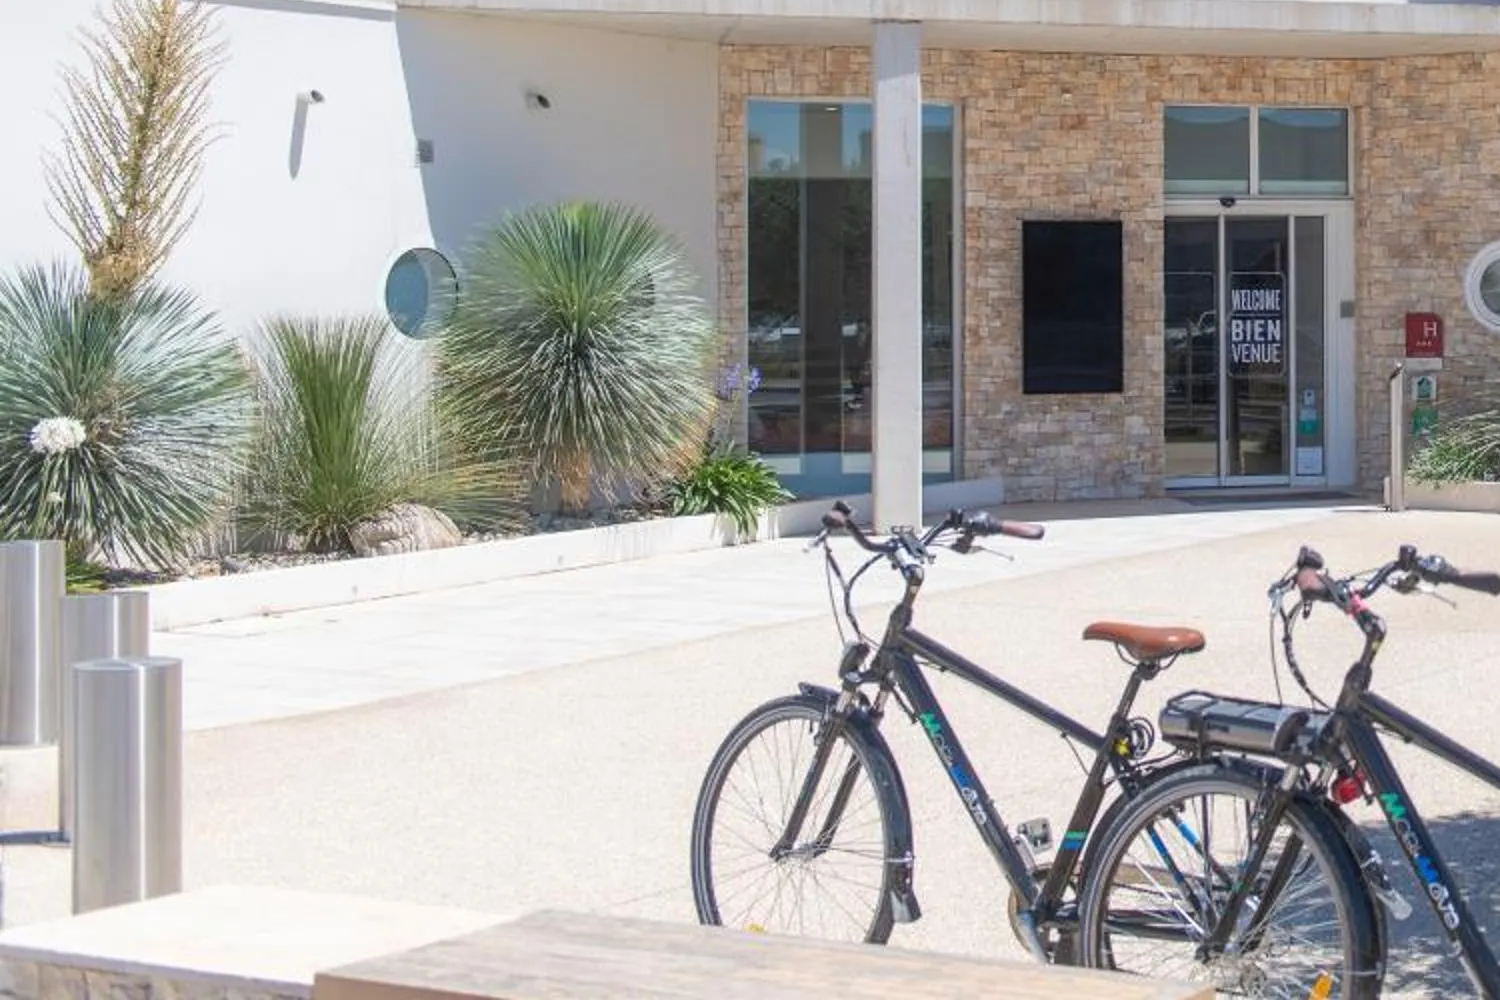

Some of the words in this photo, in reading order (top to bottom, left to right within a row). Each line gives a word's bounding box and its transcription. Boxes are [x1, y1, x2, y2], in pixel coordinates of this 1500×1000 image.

[1231, 289, 1281, 311] WELCOME
[1231, 319, 1281, 342] BIEN
[1423, 321, 1437, 337] H
[1231, 343, 1281, 363] VENUE
